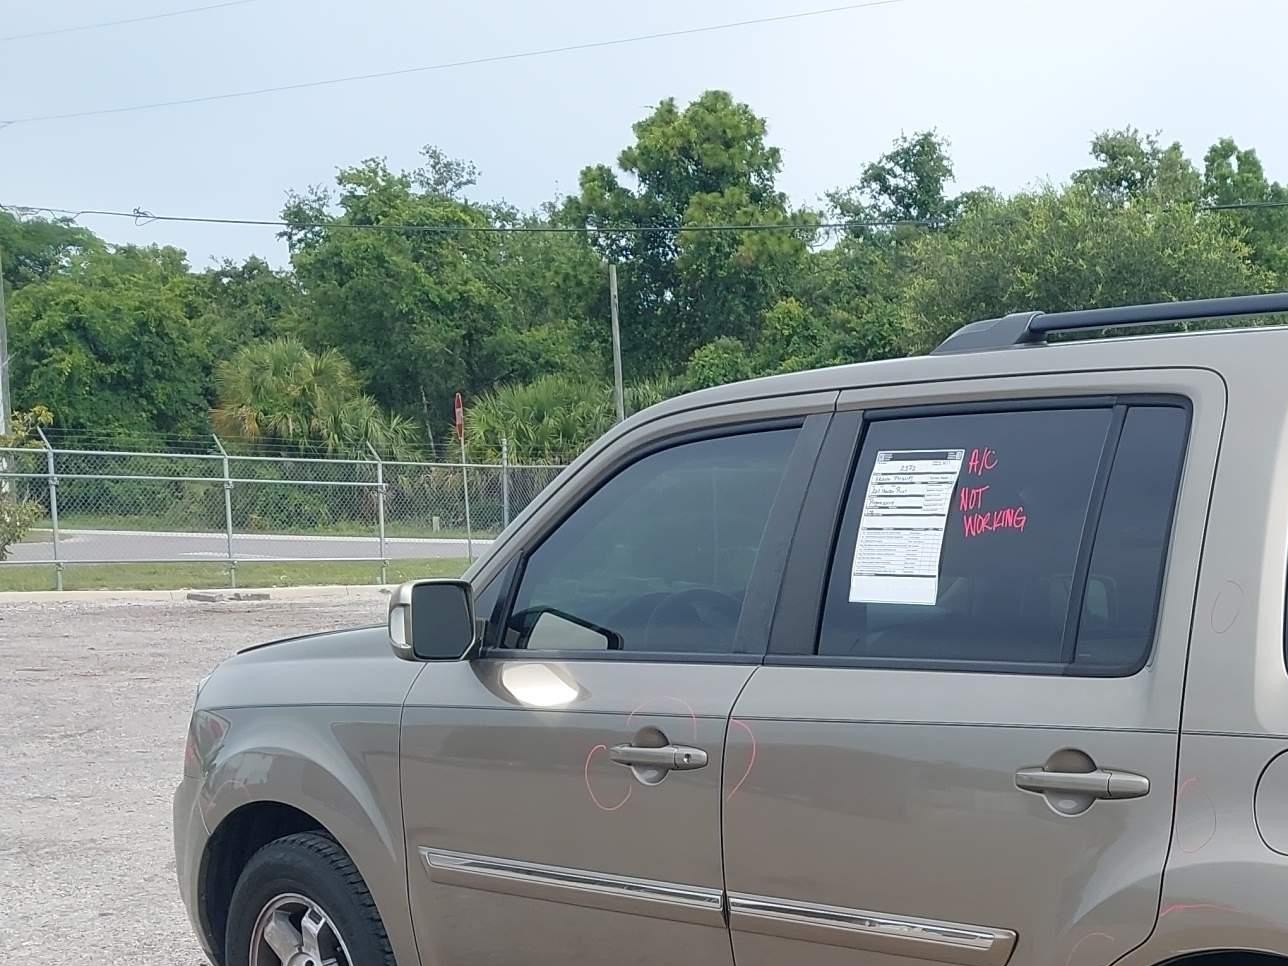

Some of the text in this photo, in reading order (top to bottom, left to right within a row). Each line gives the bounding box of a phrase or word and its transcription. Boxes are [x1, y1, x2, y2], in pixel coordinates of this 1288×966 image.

[968, 448, 999, 475] A/C
[959, 486, 990, 511] NOT
[964, 507, 1026, 536] WORKING
